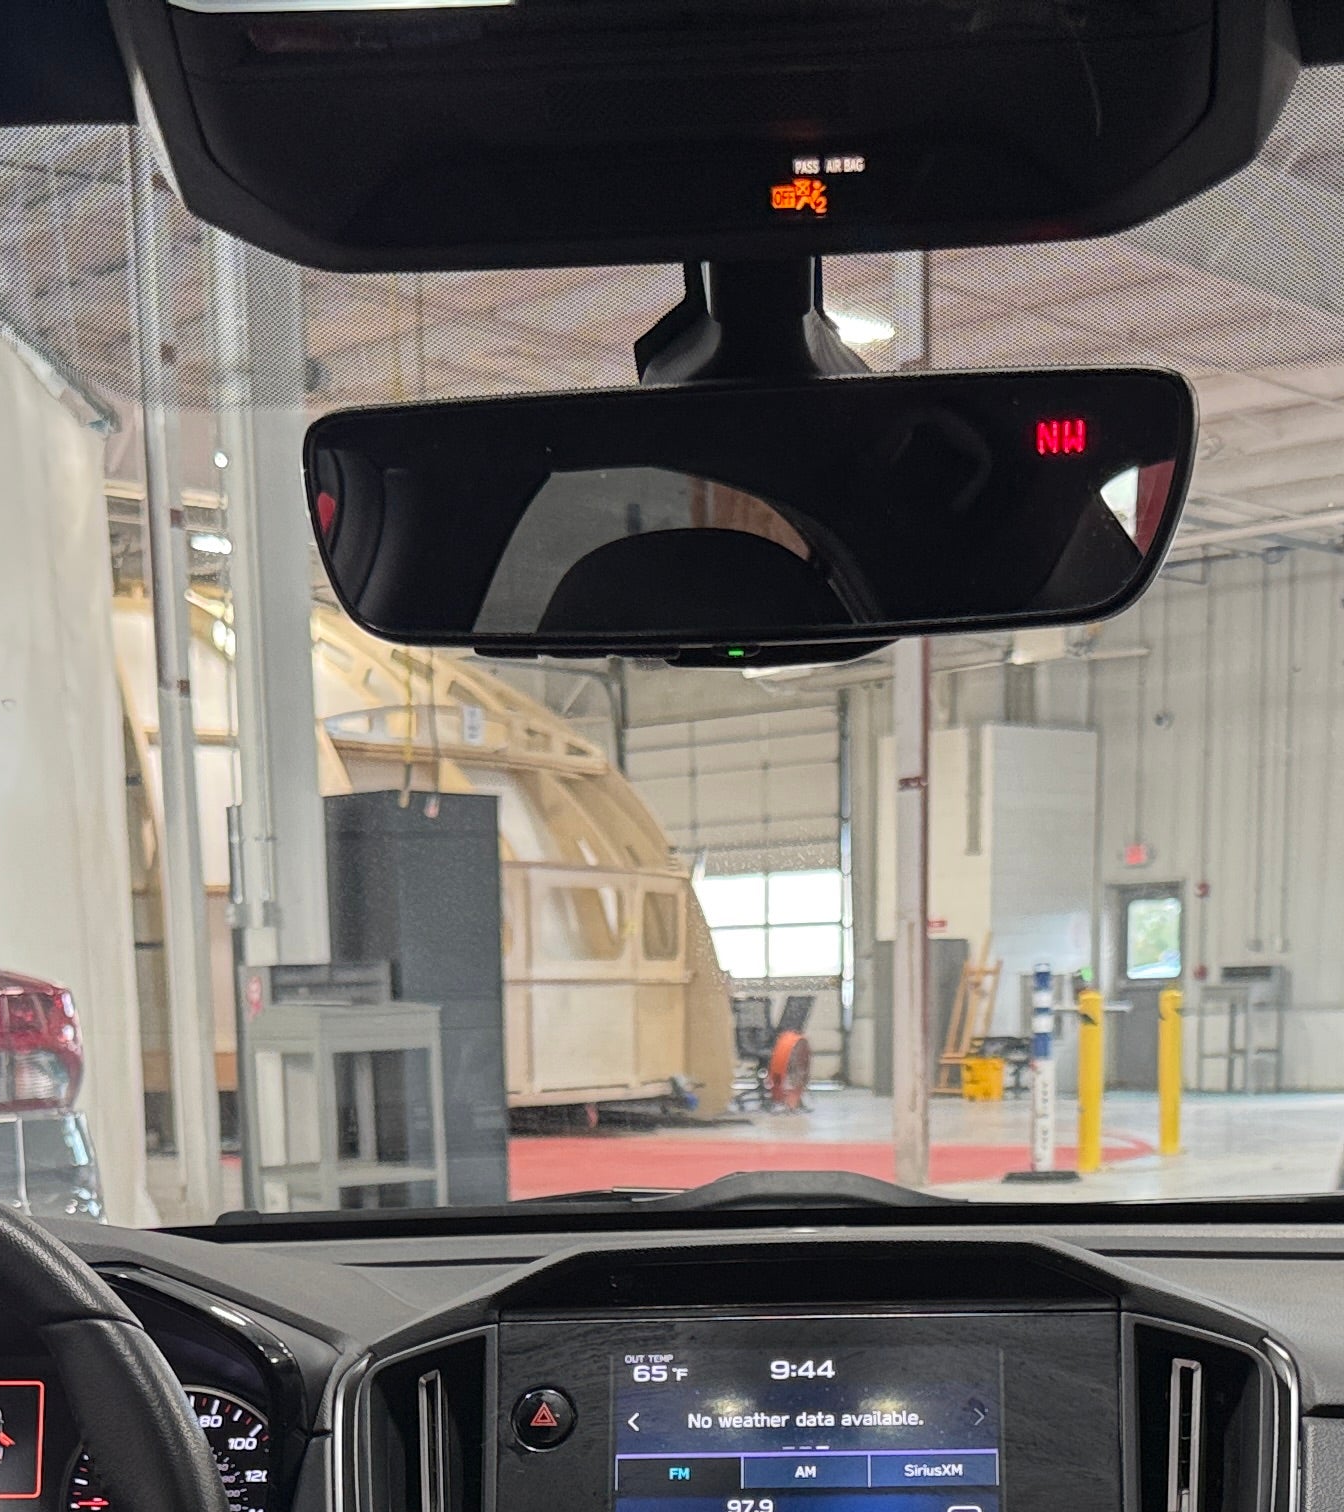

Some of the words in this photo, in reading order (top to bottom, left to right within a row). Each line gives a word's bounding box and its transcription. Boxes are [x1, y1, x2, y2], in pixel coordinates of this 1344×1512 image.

[794, 158, 821, 175] PASS
[824, 157, 842, 174] AIR
[843, 156, 865, 173] BAG
[1038, 419, 1086, 455] NW
[624, 1354, 645, 1364] OUT
[648, 1354, 674, 1364] TEMP
[633, 1365, 668, 1382] 65
[770, 1359, 836, 1380] 9:44
[200, 1415, 223, 1428] 80
[687, 1413, 713, 1429] No
[718, 1411, 790, 1428] weather
[795, 1411, 835, 1428] data
[840, 1410, 925, 1427] available.
[228, 1437, 257, 1450] 100
[668, 1466, 691, 1480] FM
[794, 1465, 817, 1479] AM
[904, 1463, 964, 1477] SiriusXM
